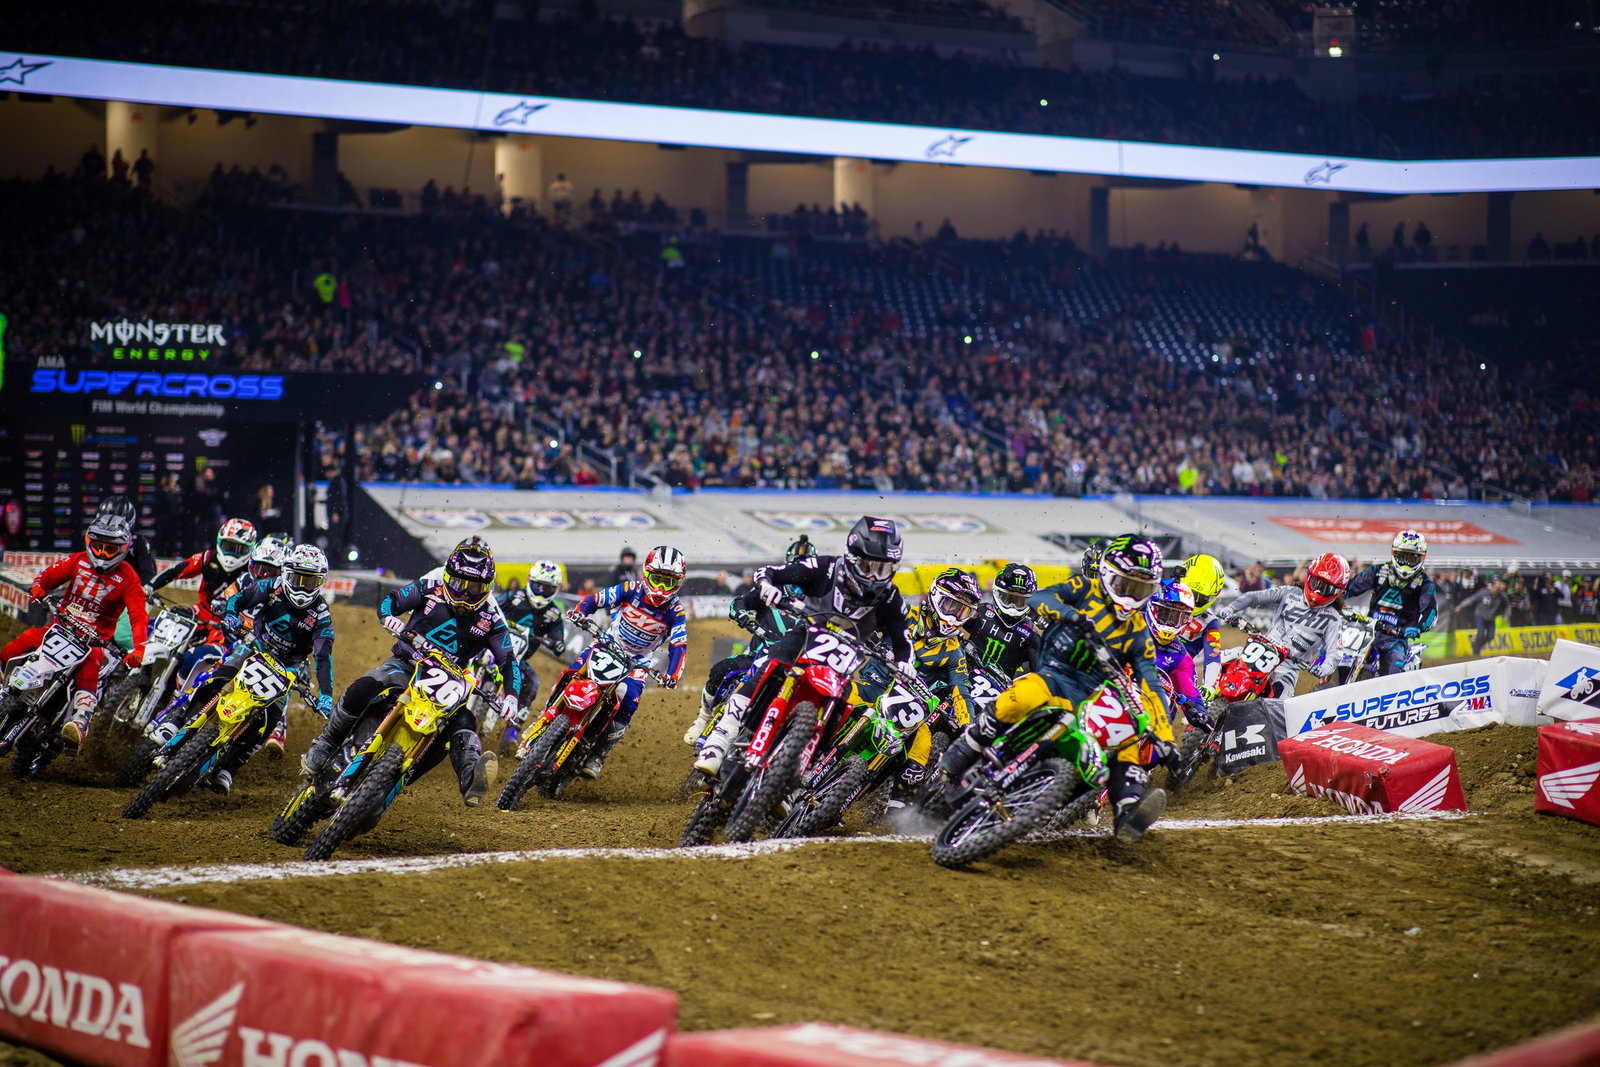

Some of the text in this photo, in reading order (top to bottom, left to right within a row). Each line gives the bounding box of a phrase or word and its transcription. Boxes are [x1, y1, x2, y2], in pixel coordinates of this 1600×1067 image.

[90, 318, 227, 346] MONSTER
[37, 355, 66, 369] AMA
[113, 348, 210, 360] ENERGY
[30, 369, 286, 399] SUPERCROSS
[115, 401, 146, 415] World
[149, 403, 225, 418] Championship
[4, 554, 57, 566] DISCO
[45, 633, 84, 667] 96
[803, 634, 855, 674] 23
[1241, 642, 1280, 673] 93
[241, 661, 285, 700] 55
[590, 651, 627, 680] 37
[414, 667, 465, 708] 26
[1336, 675, 1491, 721] SUPERCROSS
[880, 685, 925, 728] 73
[1366, 705, 1439, 730] FUTURES
[1459, 695, 1492, 711] AMA
[1089, 695, 1135, 747] 24
[1225, 745, 1266, 764] Kawasaki
[1312, 735, 1410, 765] HONDA
